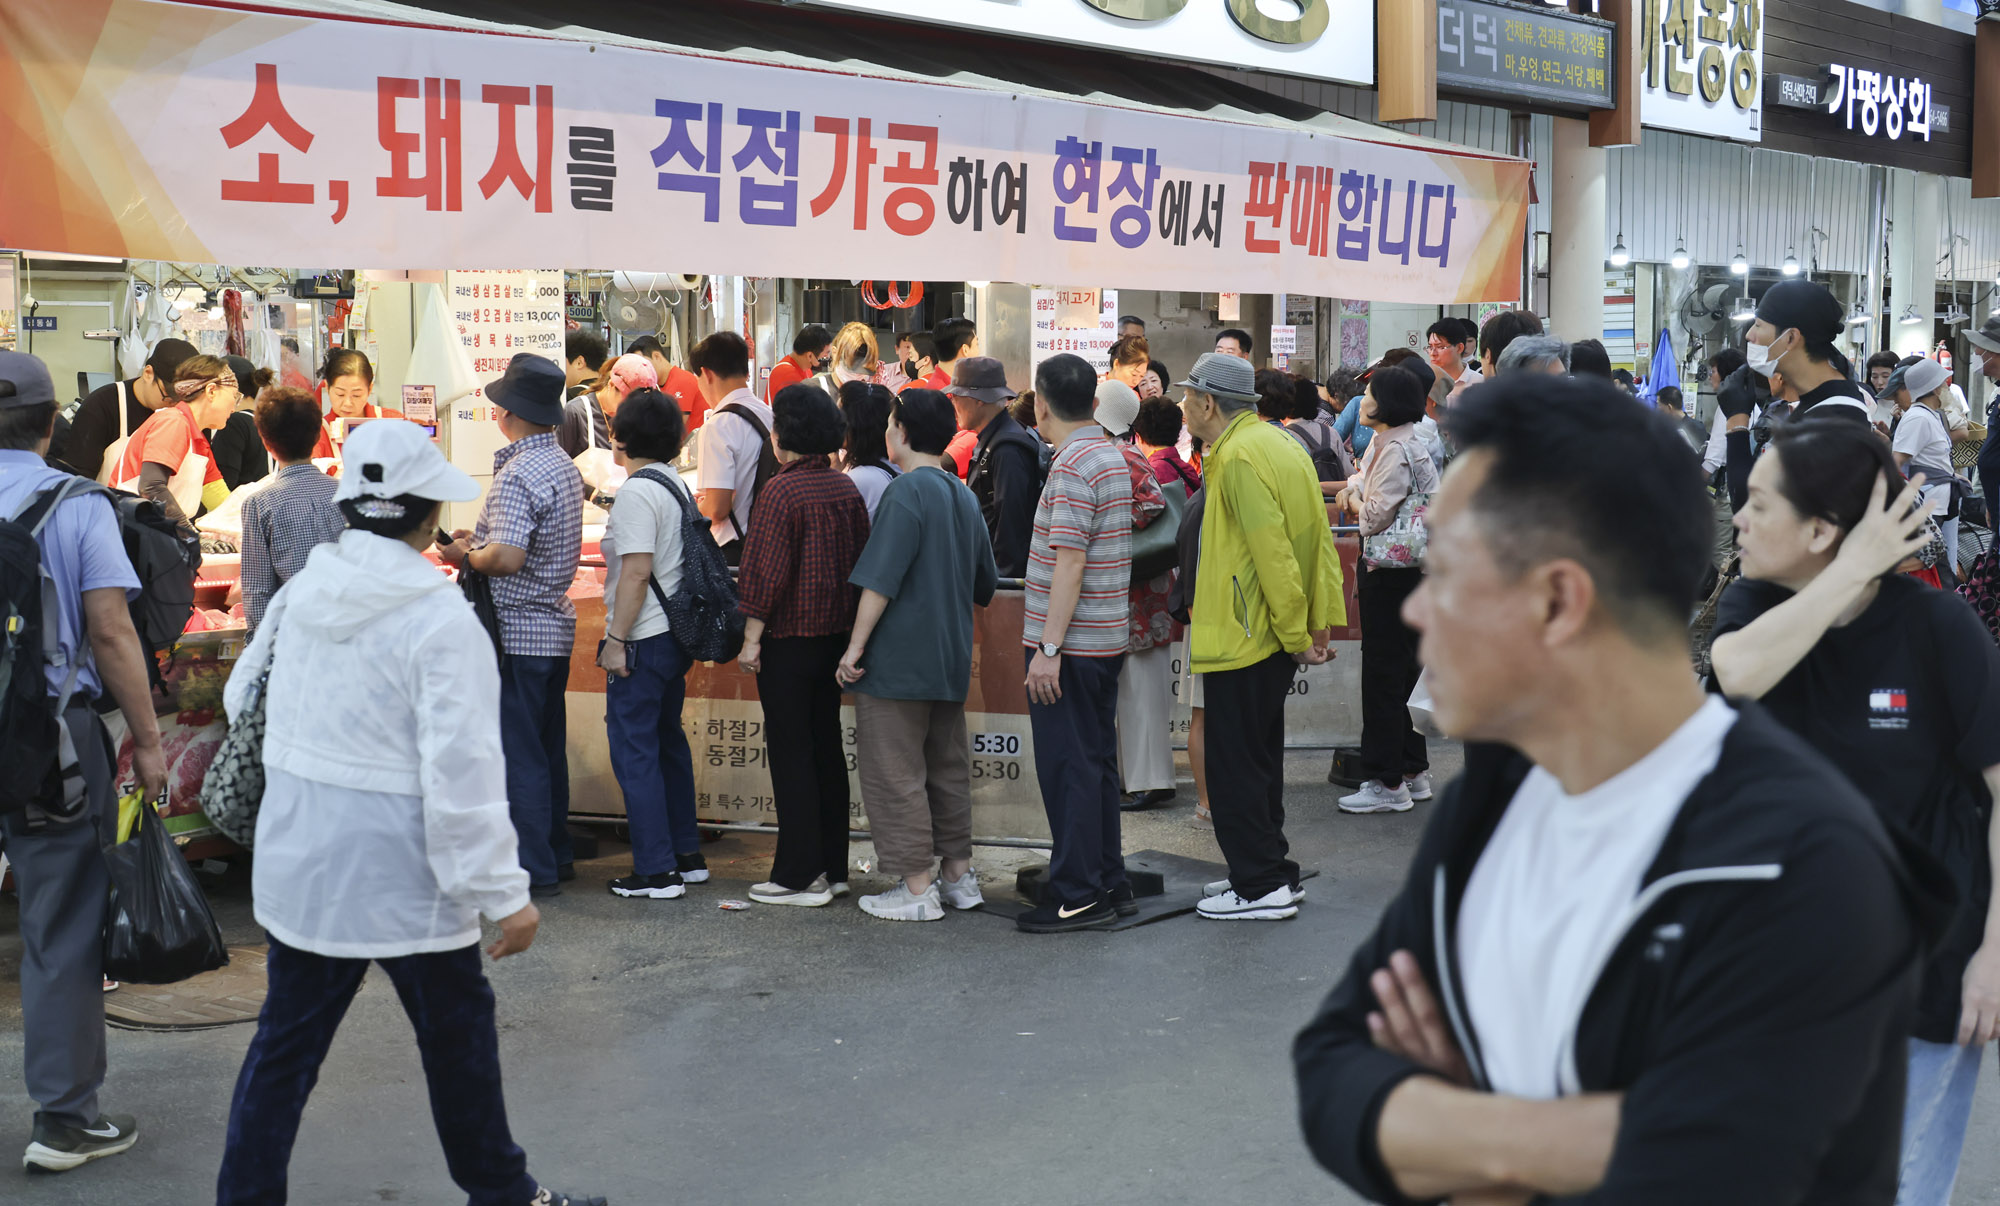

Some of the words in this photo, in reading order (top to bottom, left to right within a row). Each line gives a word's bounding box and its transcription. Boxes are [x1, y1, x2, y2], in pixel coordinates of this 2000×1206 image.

[1829, 63, 1931, 142] 가평상회
[1053, 135, 1225, 249] 현장에서
[1244, 160, 1457, 268] 판매합니다
[456, 285, 471, 297] 국내산
[456, 310, 472, 322] 국내산
[526, 310, 561, 323] 13,000
[569, 307, 593, 317] 5000
[461, 335, 472, 346] 내산
[706, 718, 766, 742] 하절기
[974, 734, 1019, 754] 5:30
[706, 744, 767, 769] 동절기
[972, 760, 1020, 780] 5:30
[716, 793, 745, 811] 특수
